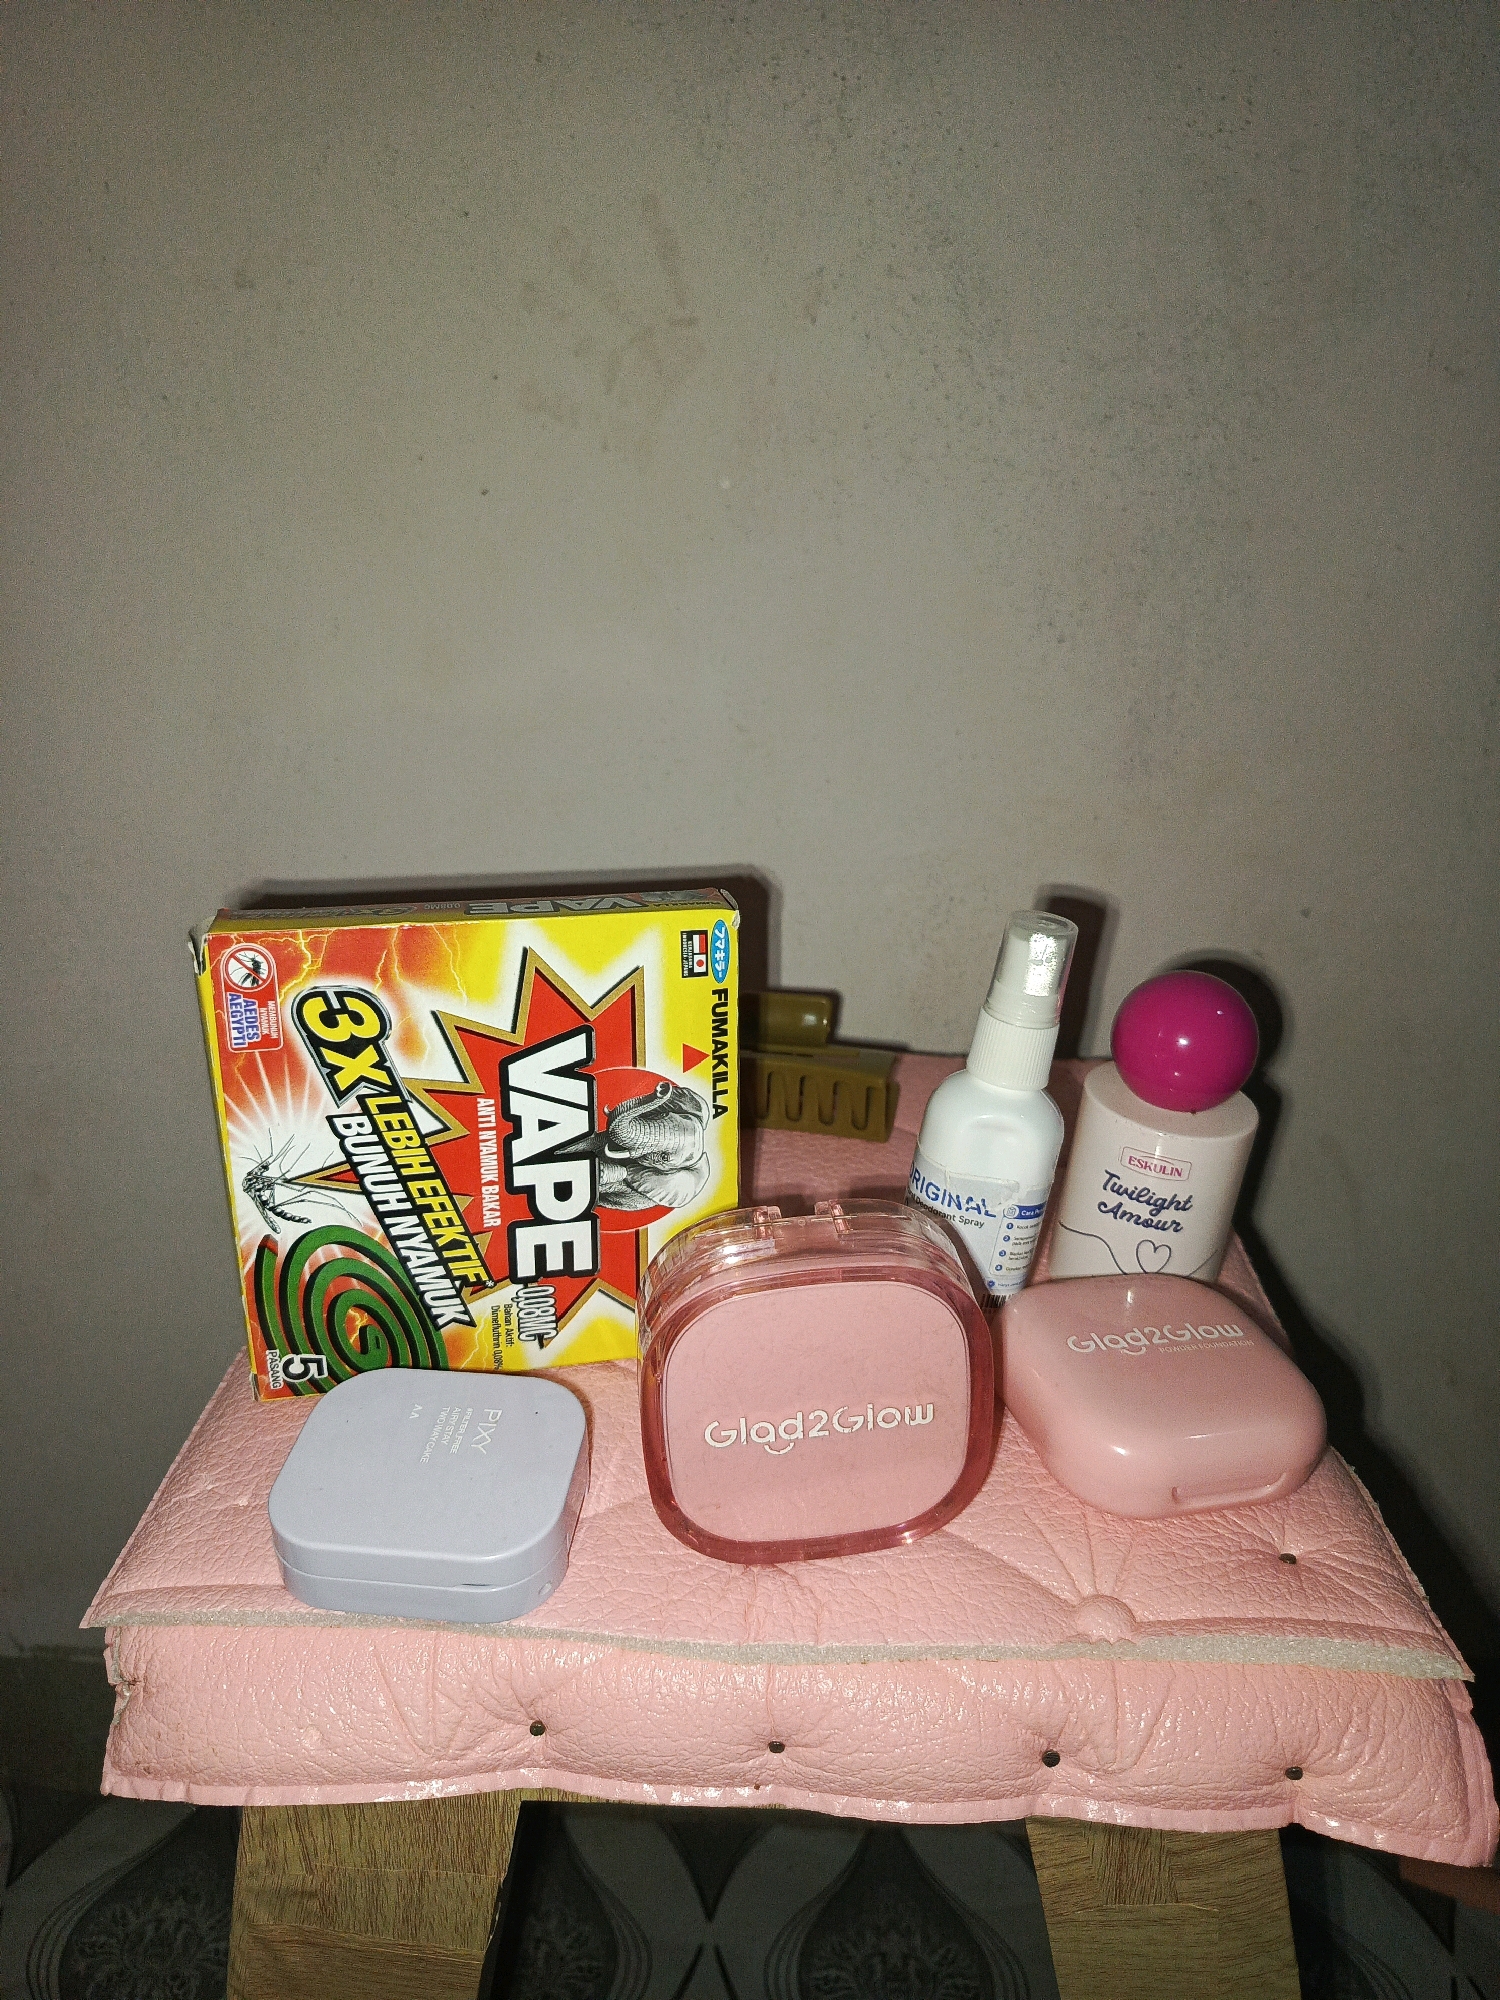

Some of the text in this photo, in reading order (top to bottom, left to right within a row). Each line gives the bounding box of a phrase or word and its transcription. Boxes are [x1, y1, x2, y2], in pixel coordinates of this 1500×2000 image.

[468, 897, 642, 914] VAPE
[714, 925, 726, 978] フマキラー
[228, 992, 247, 1047] AEGYPTI
[243, 998, 261, 1041] AEDES
[259, 1007, 270, 1035] NYAMUK
[711, 988, 730, 1120] FUMAKILLA
[364, 1094, 434, 1183] LEBIH
[506, 1031, 594, 1279] VAPE
[477, 1097, 501, 1228] ANTI NYAMUK BAKAR
[1128, 1155, 1183, 1178] ESKULIN
[915, 1195, 985, 1229] Deodorant Spray
[1102, 1169, 1194, 1217] Twilight
[333, 1115, 471, 1328] BUNUH NYAMUK
[1097, 1200, 1184, 1233] Amour
[491, 1304, 502, 1349] Dimefluthrin
[503, 1303, 513, 1327] Bahan
[511, 1285, 558, 1341] 0,08MC
[1066, 1322, 1245, 1355] Glad2Glow
[1157, 1344, 1199, 1354] POWDER
[268, 1350, 283, 1389] PASANG
[282, 1356, 325, 1381] 5
[419, 1406, 451, 1464] TWO WAY CAKE
[440, 1406, 462, 1446] AIRY STAY
[470, 1408, 503, 1455] PIXY
[703, 1402, 935, 1455] Glad2Glow
